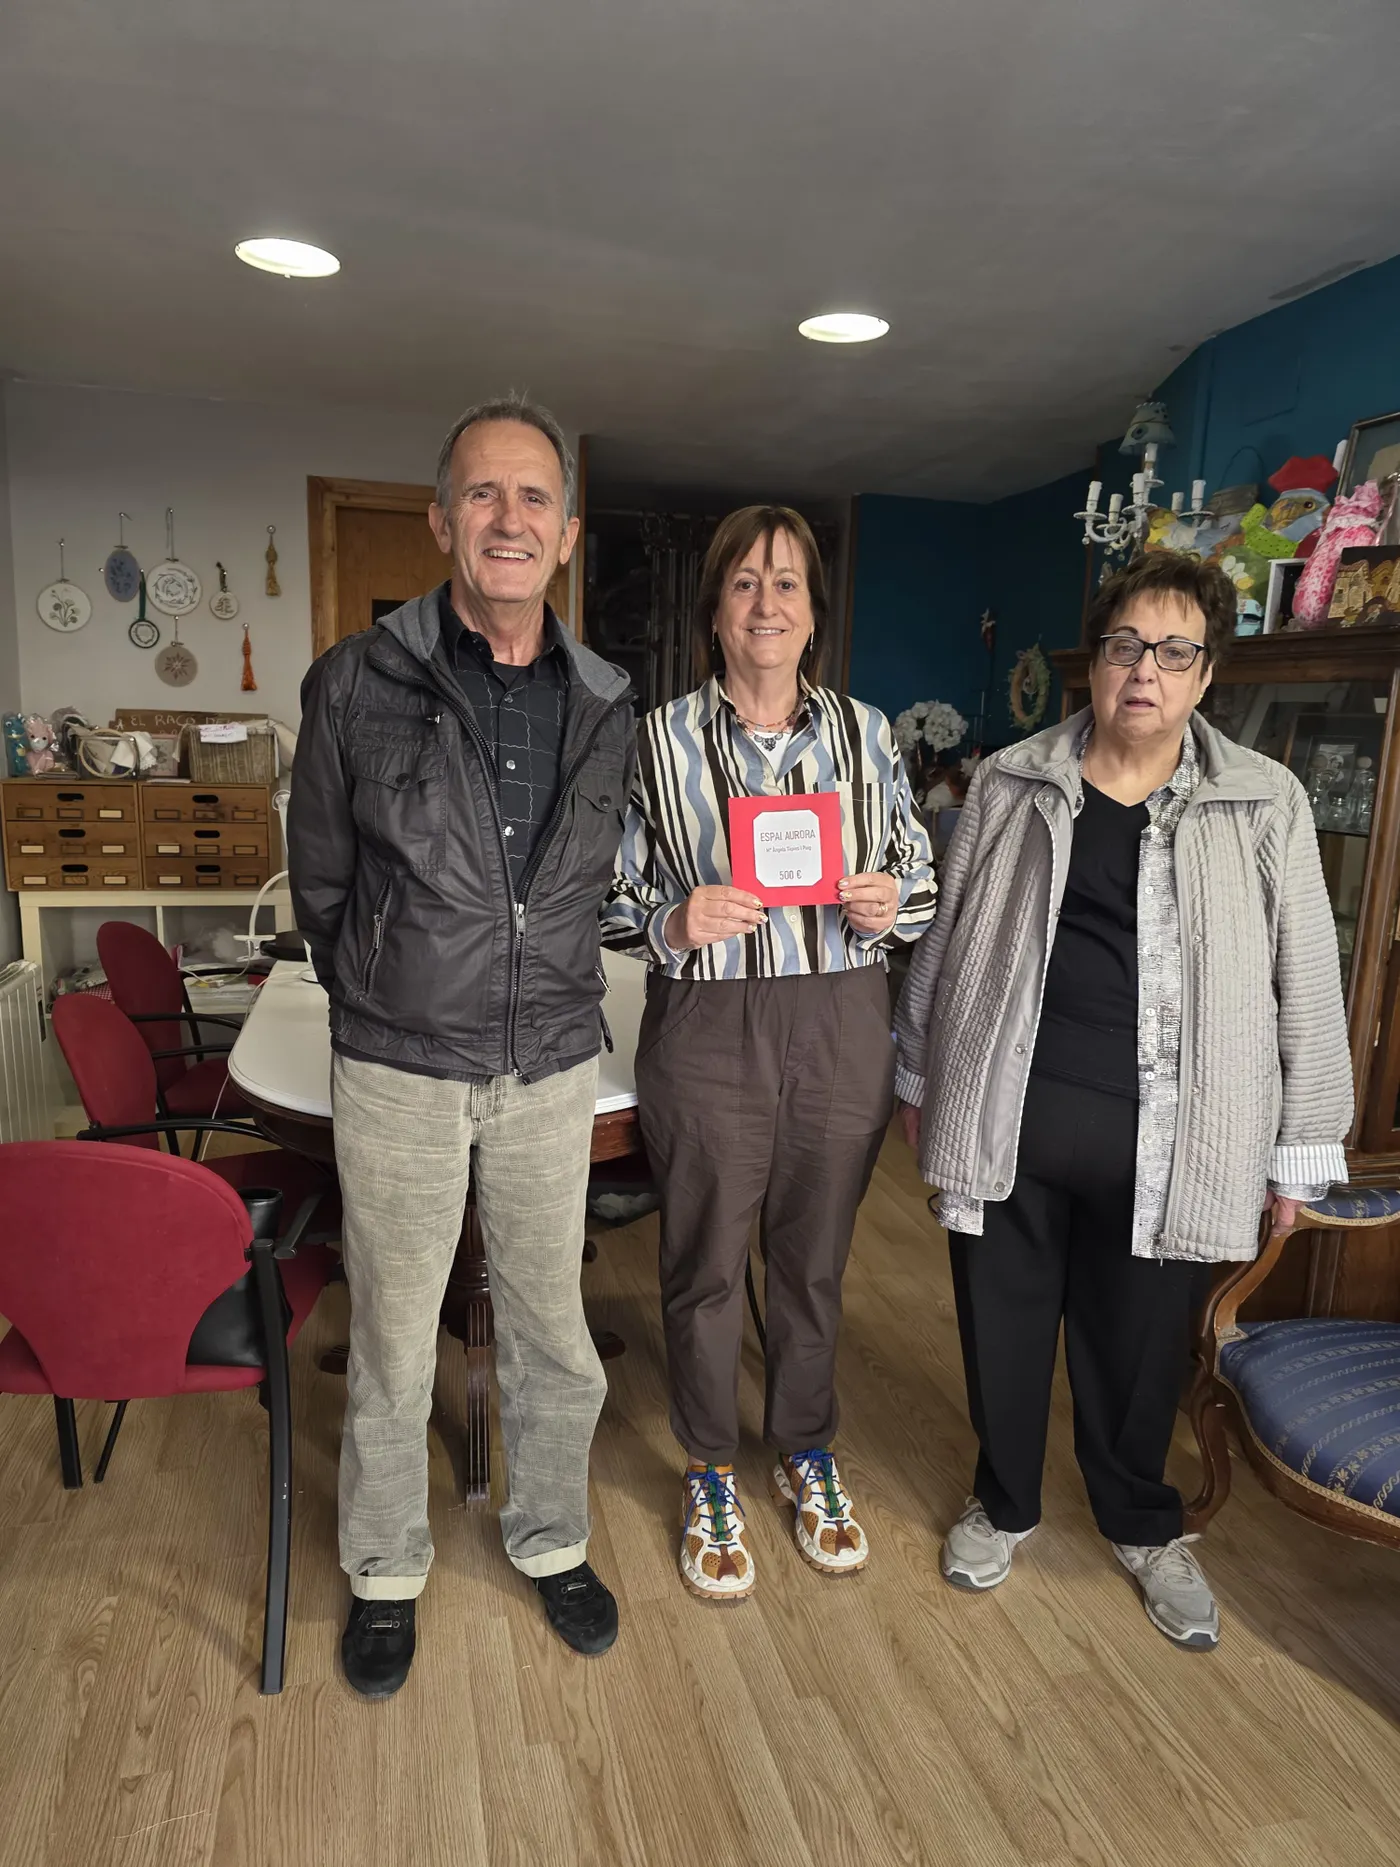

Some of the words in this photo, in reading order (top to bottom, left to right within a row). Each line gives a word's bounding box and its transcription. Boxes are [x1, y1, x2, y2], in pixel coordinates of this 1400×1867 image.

[760, 831, 783, 842] ESPAI
[784, 829, 816, 841] AURORA
[779, 870, 795, 880] 500
[796, 869, 803, 880] €
